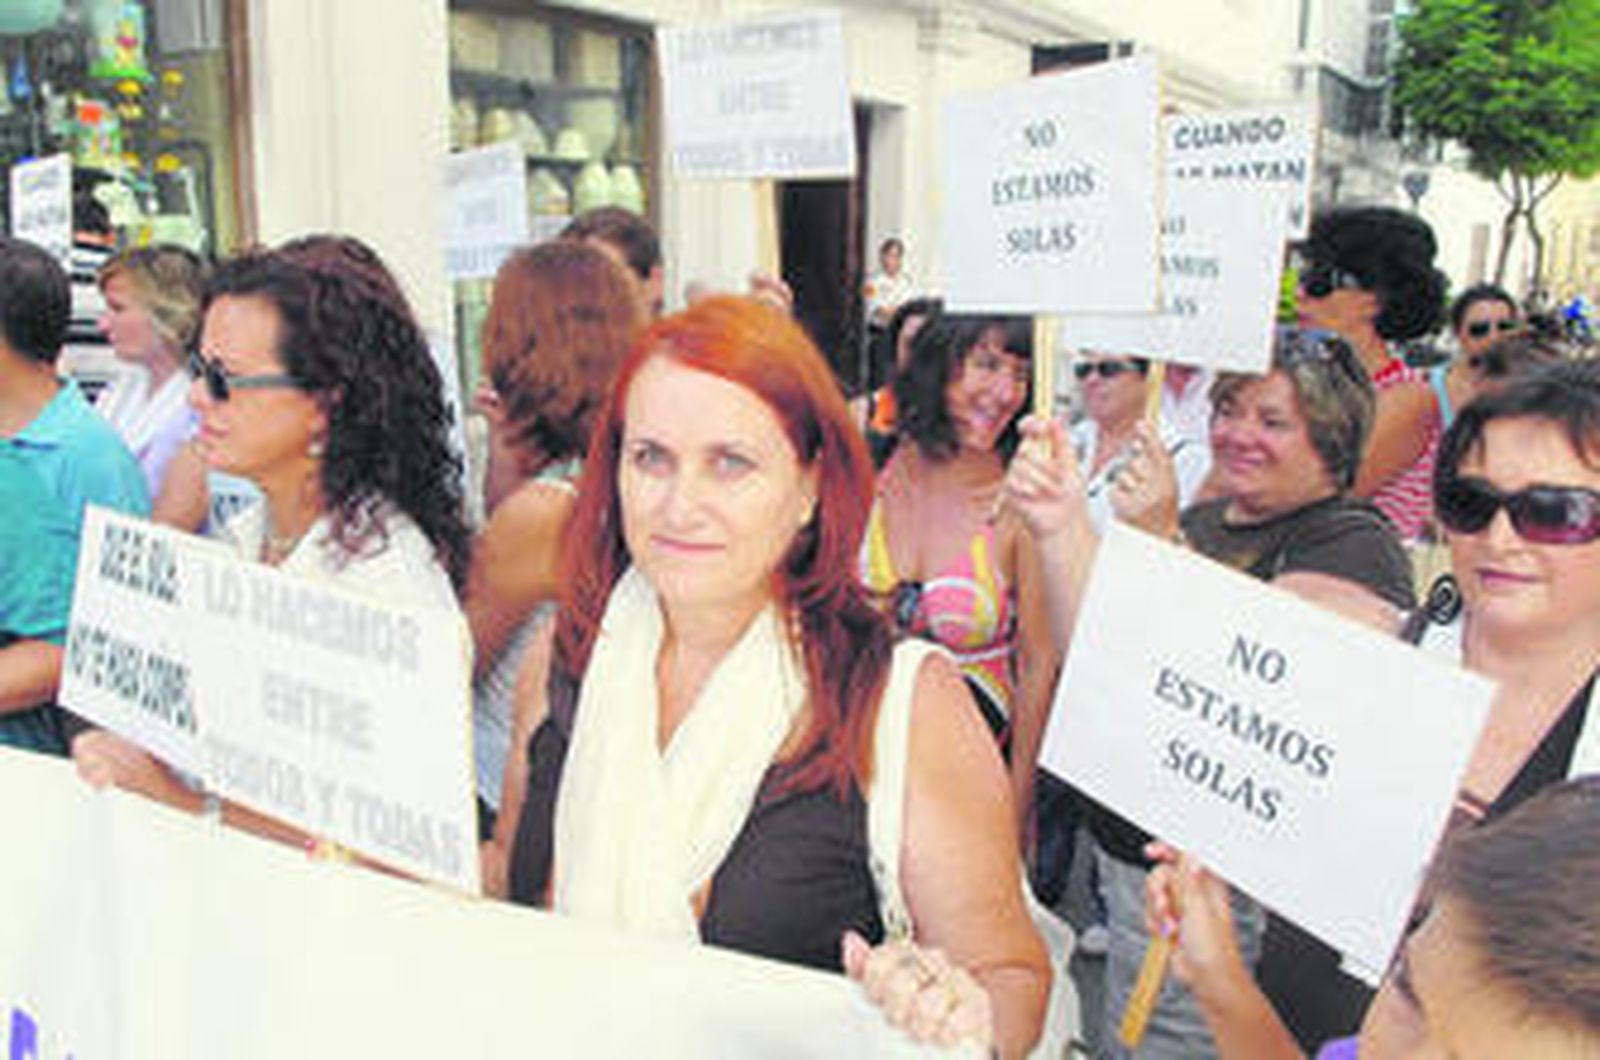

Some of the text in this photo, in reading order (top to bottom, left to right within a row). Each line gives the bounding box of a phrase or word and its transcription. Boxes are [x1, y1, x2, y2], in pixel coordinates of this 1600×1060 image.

[1023, 119, 1059, 148] NO
[1175, 117, 1286, 149] CUANDO
[991, 166, 1097, 207] ESTAMOS
[1006, 222, 1079, 254] SOLAS
[1227, 634, 1288, 684] NO
[1154, 667, 1336, 779] ESTAMOS
[1162, 736, 1282, 824] SOLAS
